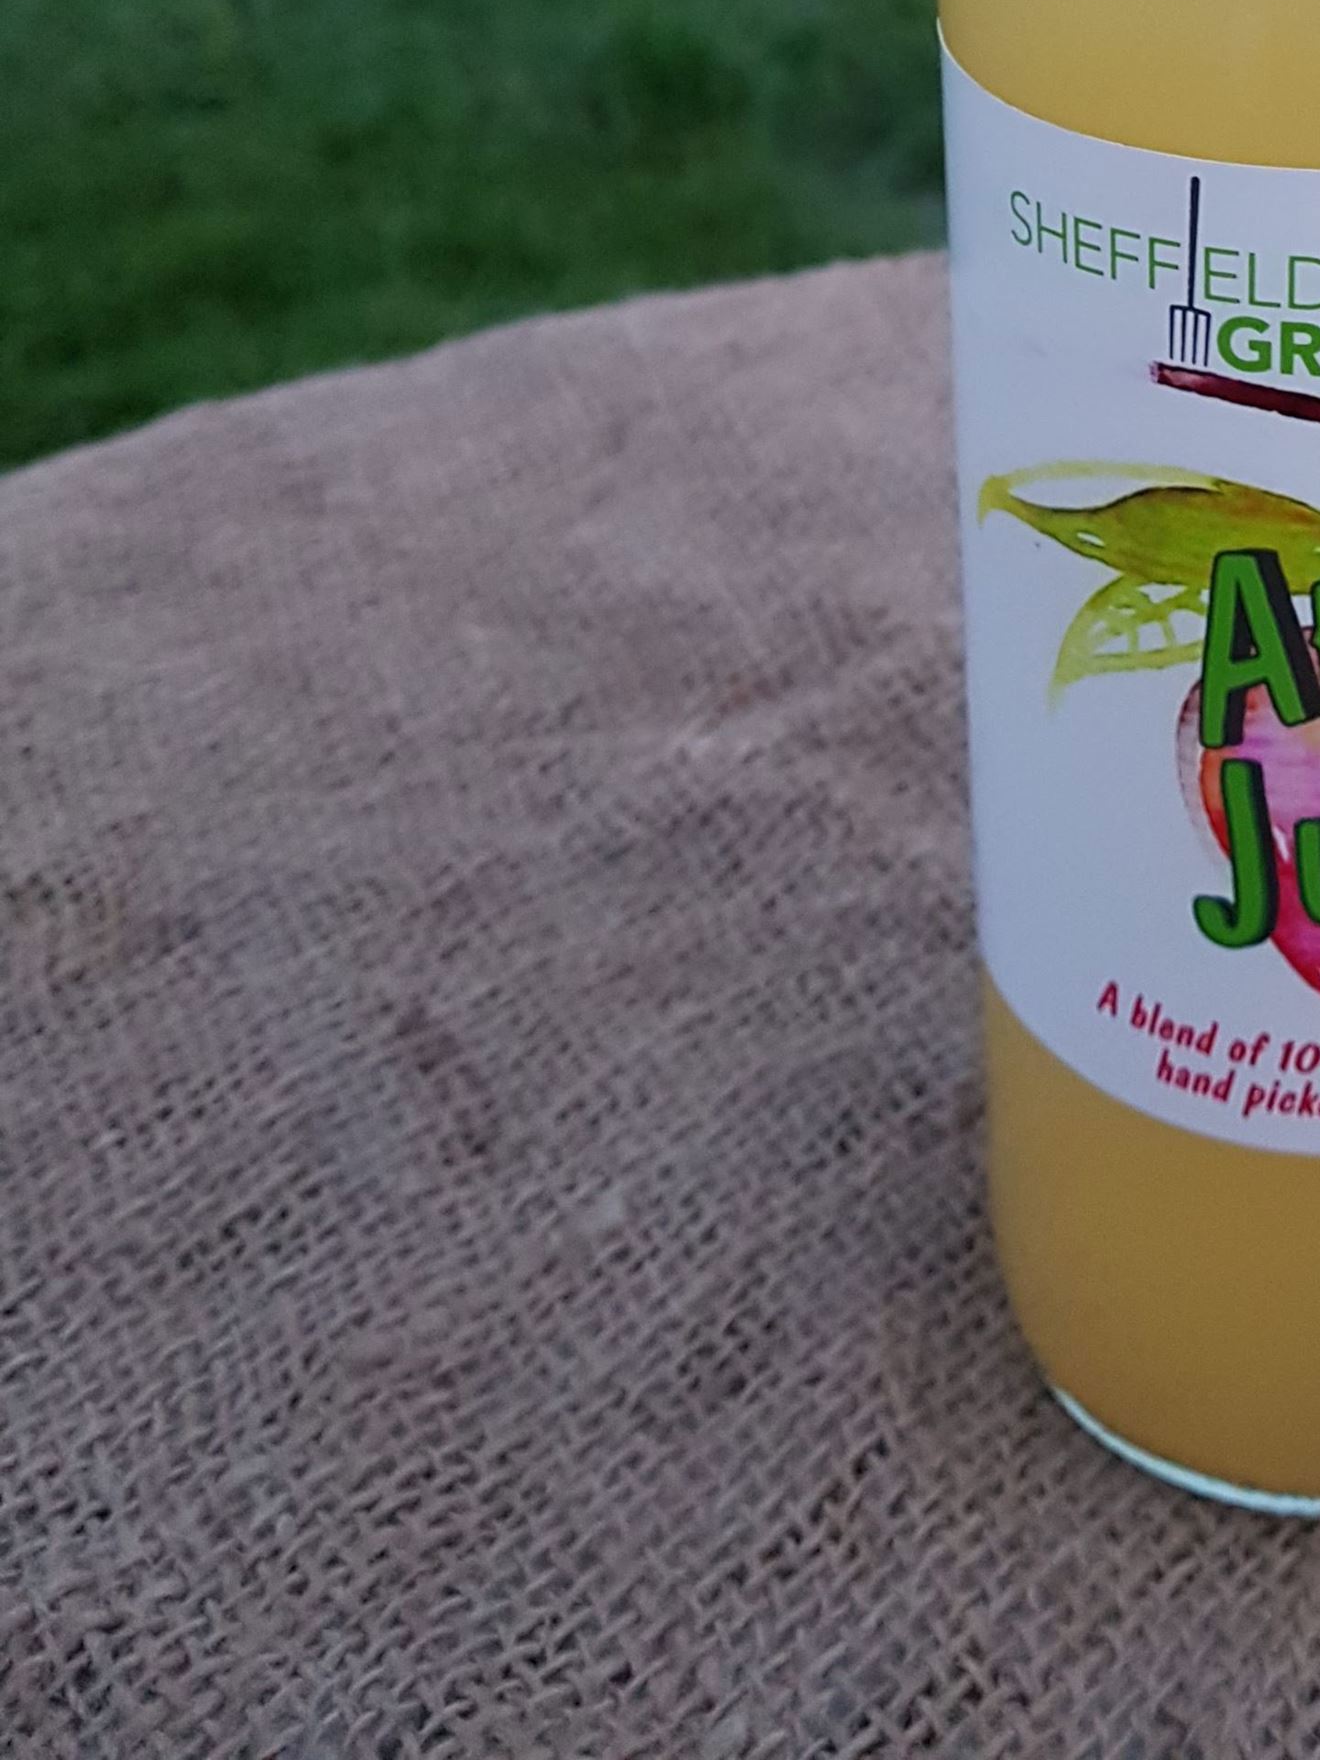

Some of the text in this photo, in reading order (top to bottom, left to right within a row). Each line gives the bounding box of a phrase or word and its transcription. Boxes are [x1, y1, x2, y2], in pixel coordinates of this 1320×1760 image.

[1097, 981, 1118, 1017] A
[1130, 995, 1220, 1057] blend
[1229, 1034, 1270, 1072] of
[1156, 1048, 1236, 1102] hand
